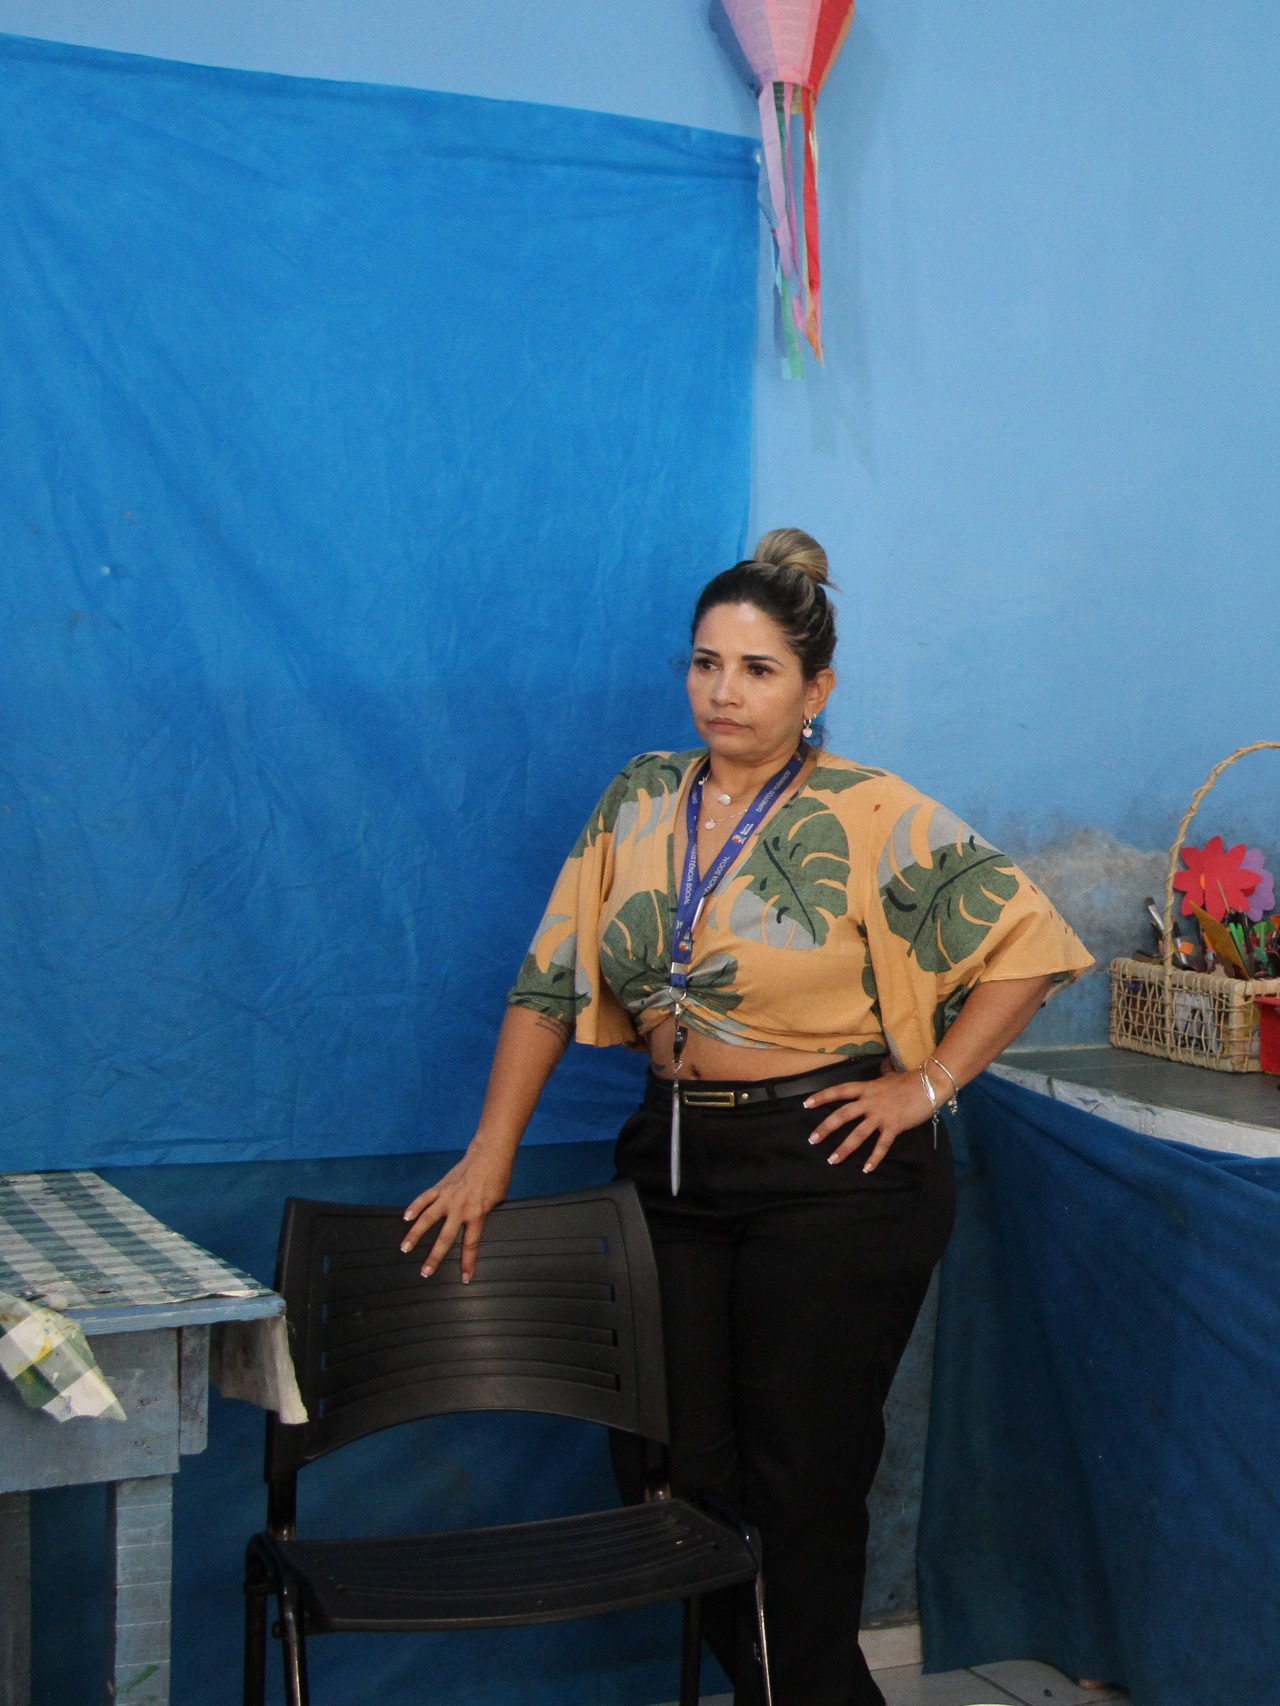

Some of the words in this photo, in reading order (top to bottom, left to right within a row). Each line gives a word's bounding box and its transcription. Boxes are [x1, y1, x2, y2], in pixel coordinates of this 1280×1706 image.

[756, 789, 775, 813] DIREITOS
[714, 855, 732, 876] SOCIAL
[683, 882, 693, 905] SOCIAL
